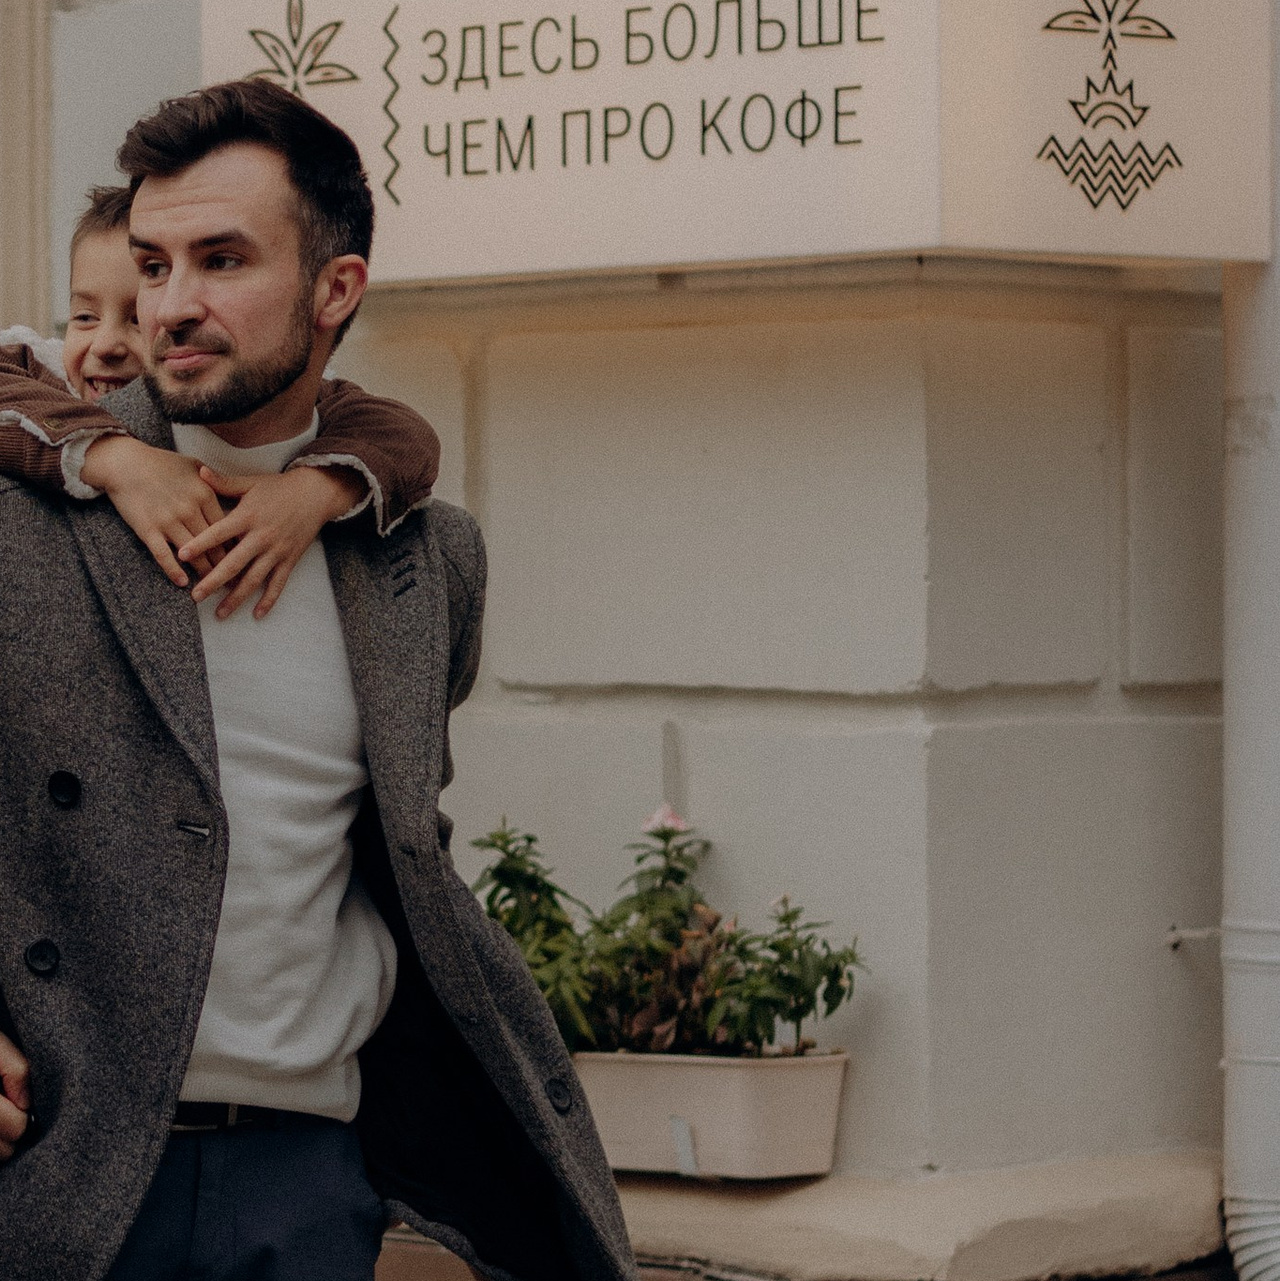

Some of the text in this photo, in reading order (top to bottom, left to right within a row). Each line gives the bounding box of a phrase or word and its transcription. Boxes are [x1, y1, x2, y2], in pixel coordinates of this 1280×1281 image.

[420, 14, 601, 93] ЗДЕСЬ
[423, 84, 864, 177] ЧЕМ ПРО КОФЕ
